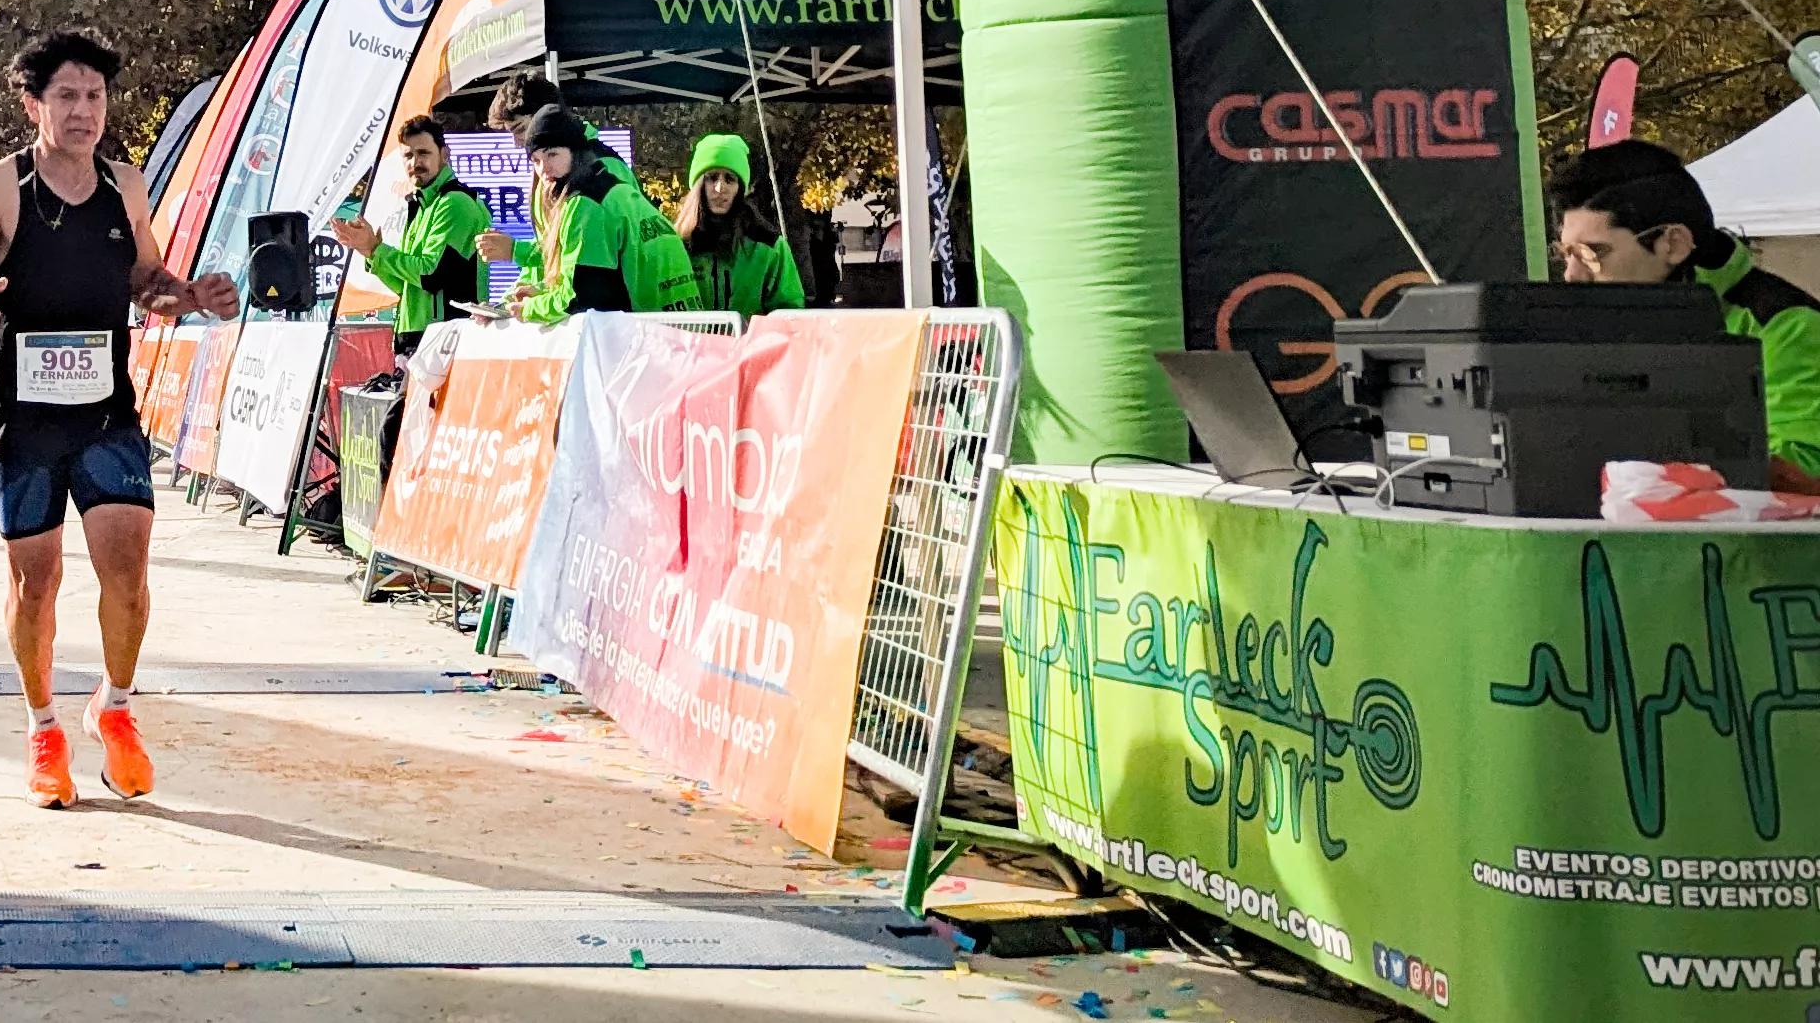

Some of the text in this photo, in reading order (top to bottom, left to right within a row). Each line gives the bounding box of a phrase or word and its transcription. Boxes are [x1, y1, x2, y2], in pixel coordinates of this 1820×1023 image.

[1248, 147, 1363, 162] GRUPO
[33, 371, 98, 380] FERNANDO
[41, 350, 92, 370] 905
[430, 425, 503, 478] ESPIAS
[1184, 670, 1348, 868] Sport
[1516, 848, 1650, 877] EVENTOS
[1473, 863, 1809, 907] CRONOMETRAJE EVENTOS
[1641, 948, 1820, 989] www.f
